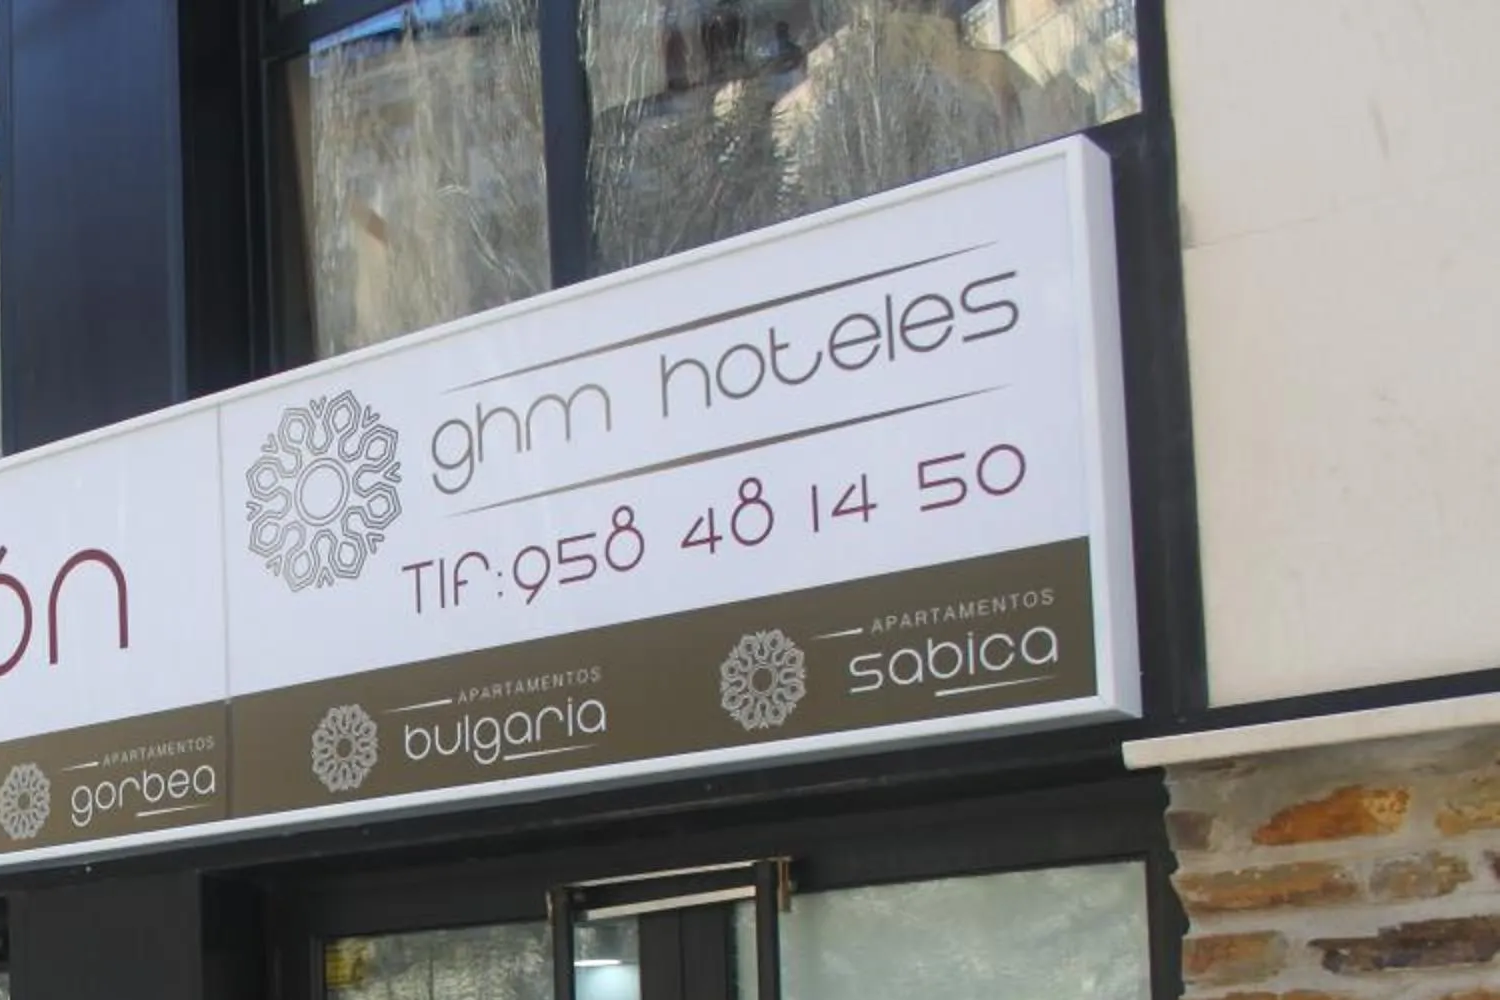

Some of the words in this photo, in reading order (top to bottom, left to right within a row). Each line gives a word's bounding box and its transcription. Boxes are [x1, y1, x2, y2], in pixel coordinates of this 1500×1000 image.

[430, 381, 612, 496] ghm
[660, 270, 1020, 418] hoteles
[680, 476, 775, 556] 48
[811, 473, 877, 533] 14
[917, 443, 1027, 512] 50
[871, 589, 1055, 633] APARTAMENTOS
[457, 666, 602, 704] APARTAMENTOS
[849, 626, 1059, 694] sabica
[102, 735, 215, 768] APARTAMENTOS
[404, 697, 607, 765] bulgaria
[71, 765, 216, 827] gorbea
